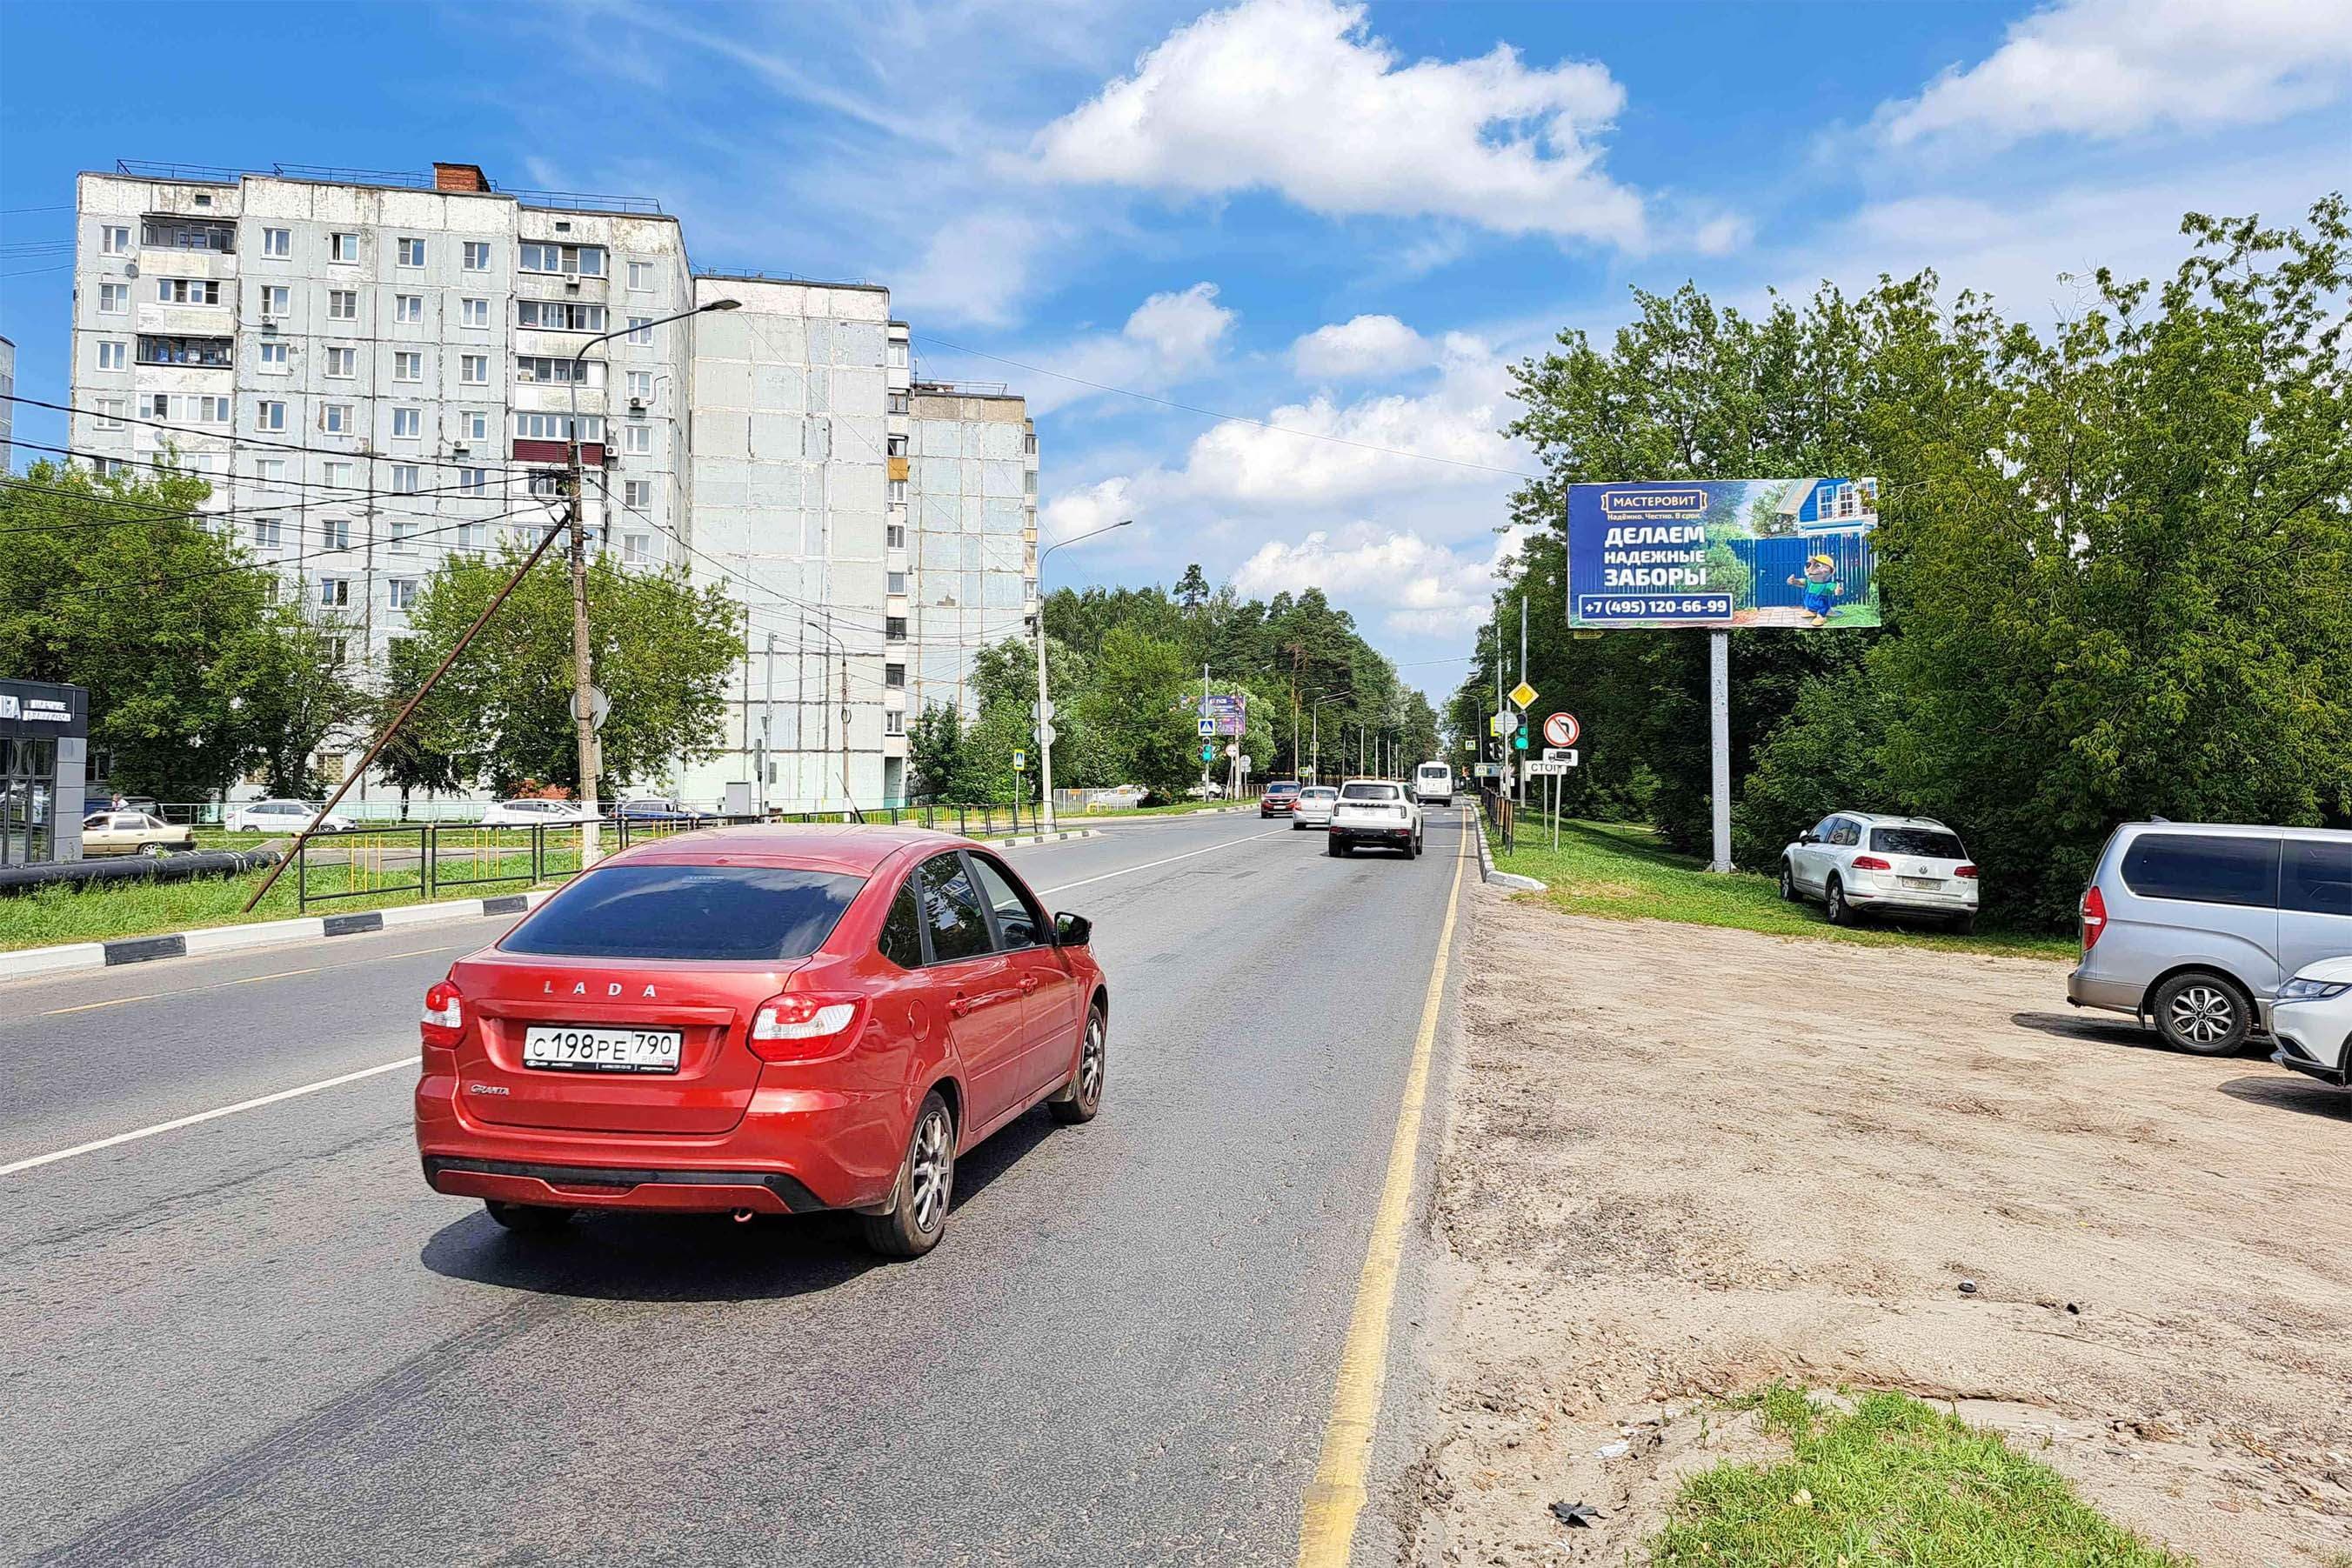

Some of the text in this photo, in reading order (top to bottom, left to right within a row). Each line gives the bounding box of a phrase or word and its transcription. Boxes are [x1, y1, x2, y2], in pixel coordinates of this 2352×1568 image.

[1614, 496, 1696, 507] МАСТЕРОВИТ
[1604, 525, 1706, 548] ДЕЛАЕМ
[1604, 550, 1706, 565] НАДЕЖНЫЕ
[1604, 568, 1707, 587] ЗАБОРЫ
[1585, 600, 1727, 615] +7 (495) 120-66-99
[544, 980, 657, 998] LADA
[634, 1034, 672, 1055] 790
[641, 1055, 661, 1064] RUS
